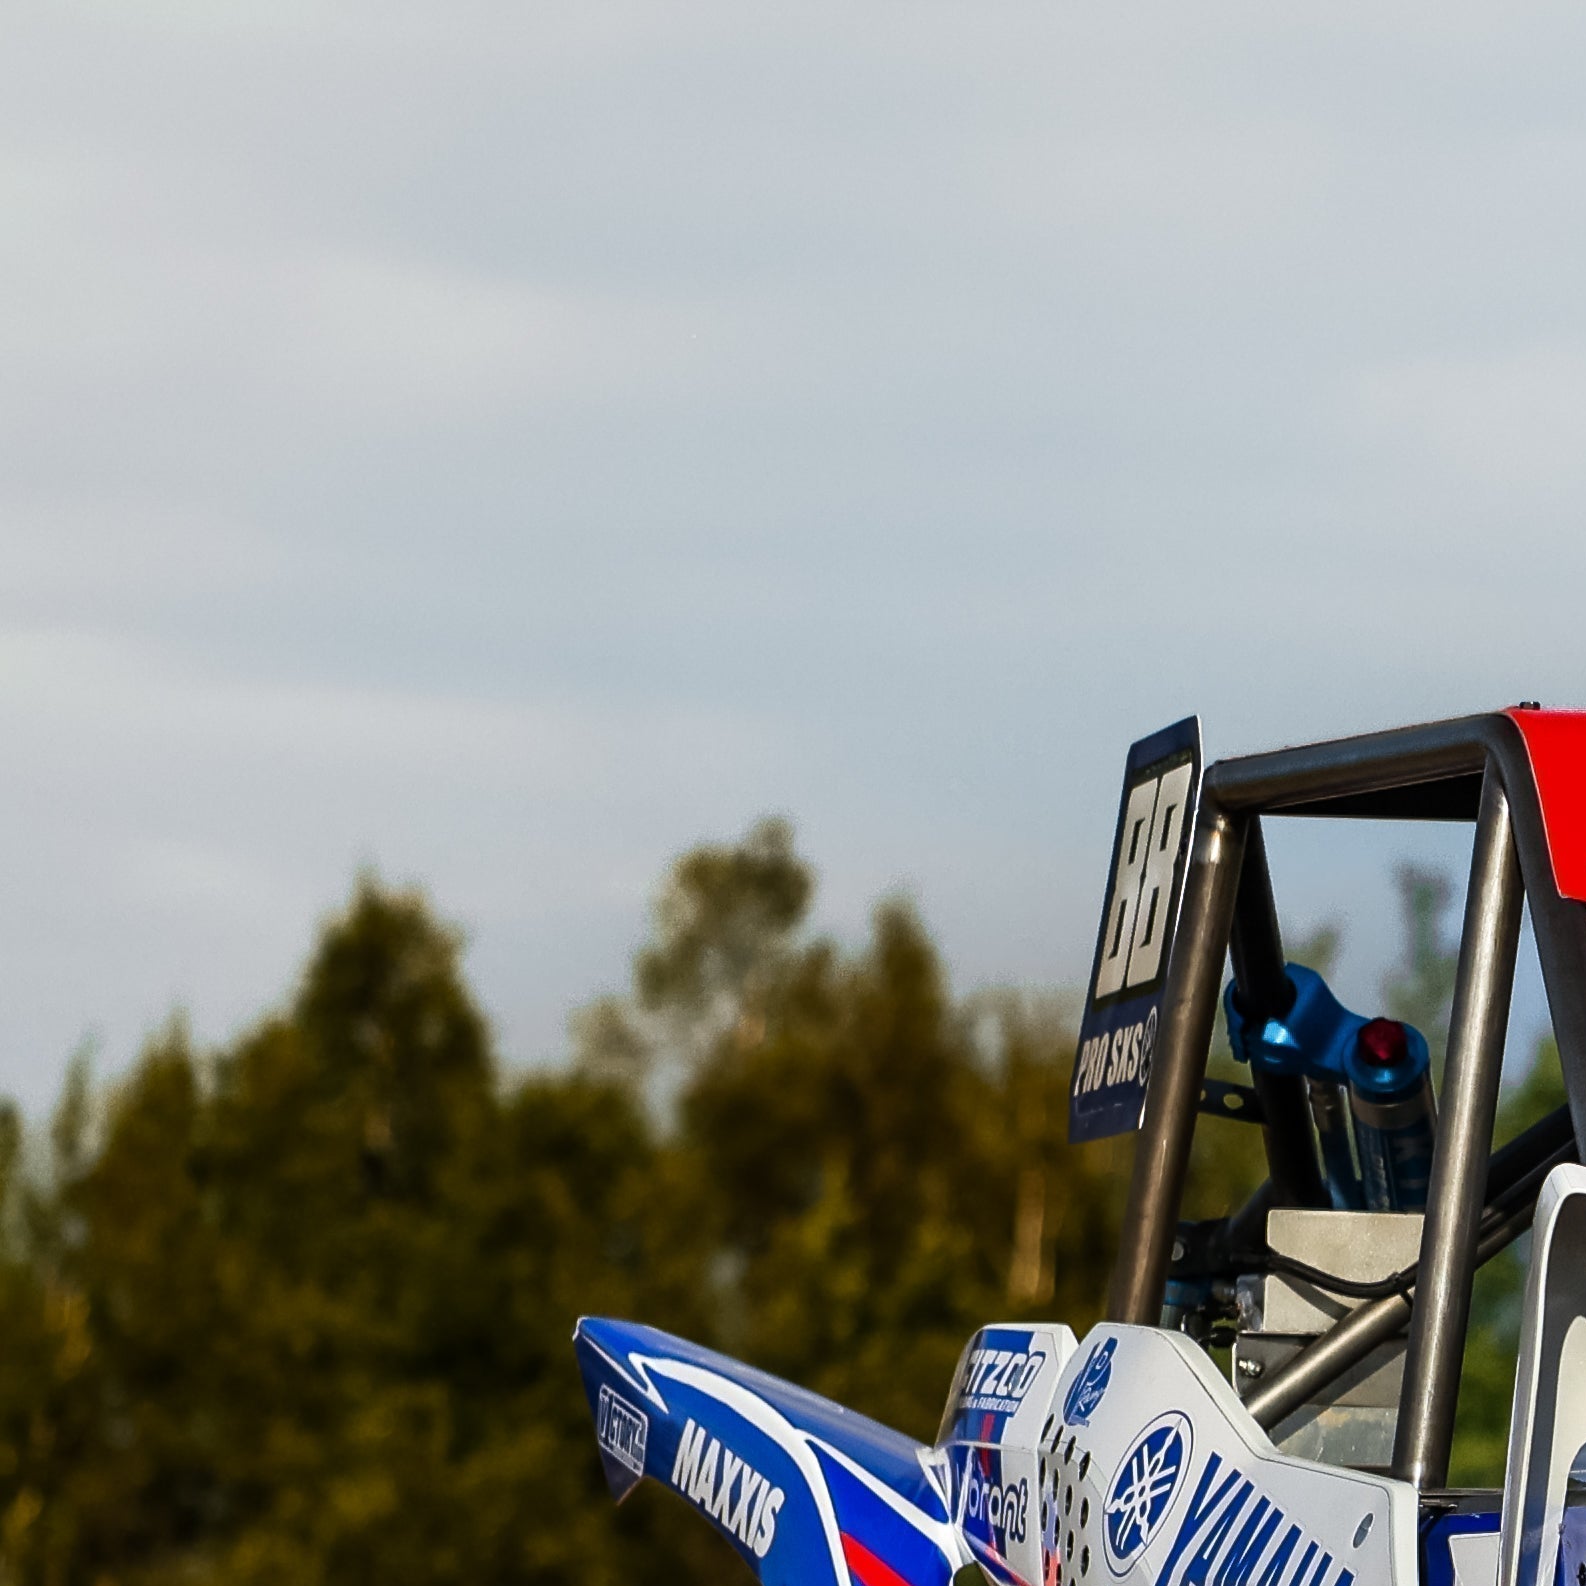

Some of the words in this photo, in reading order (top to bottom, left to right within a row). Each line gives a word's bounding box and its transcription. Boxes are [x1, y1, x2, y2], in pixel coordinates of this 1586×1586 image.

[1095, 763, 1192, 999] 88
[1074, 1034, 1104, 1097] PRO
[1106, 1026, 1143, 1092] SXS
[671, 1418, 785, 1558] MAXXIS
